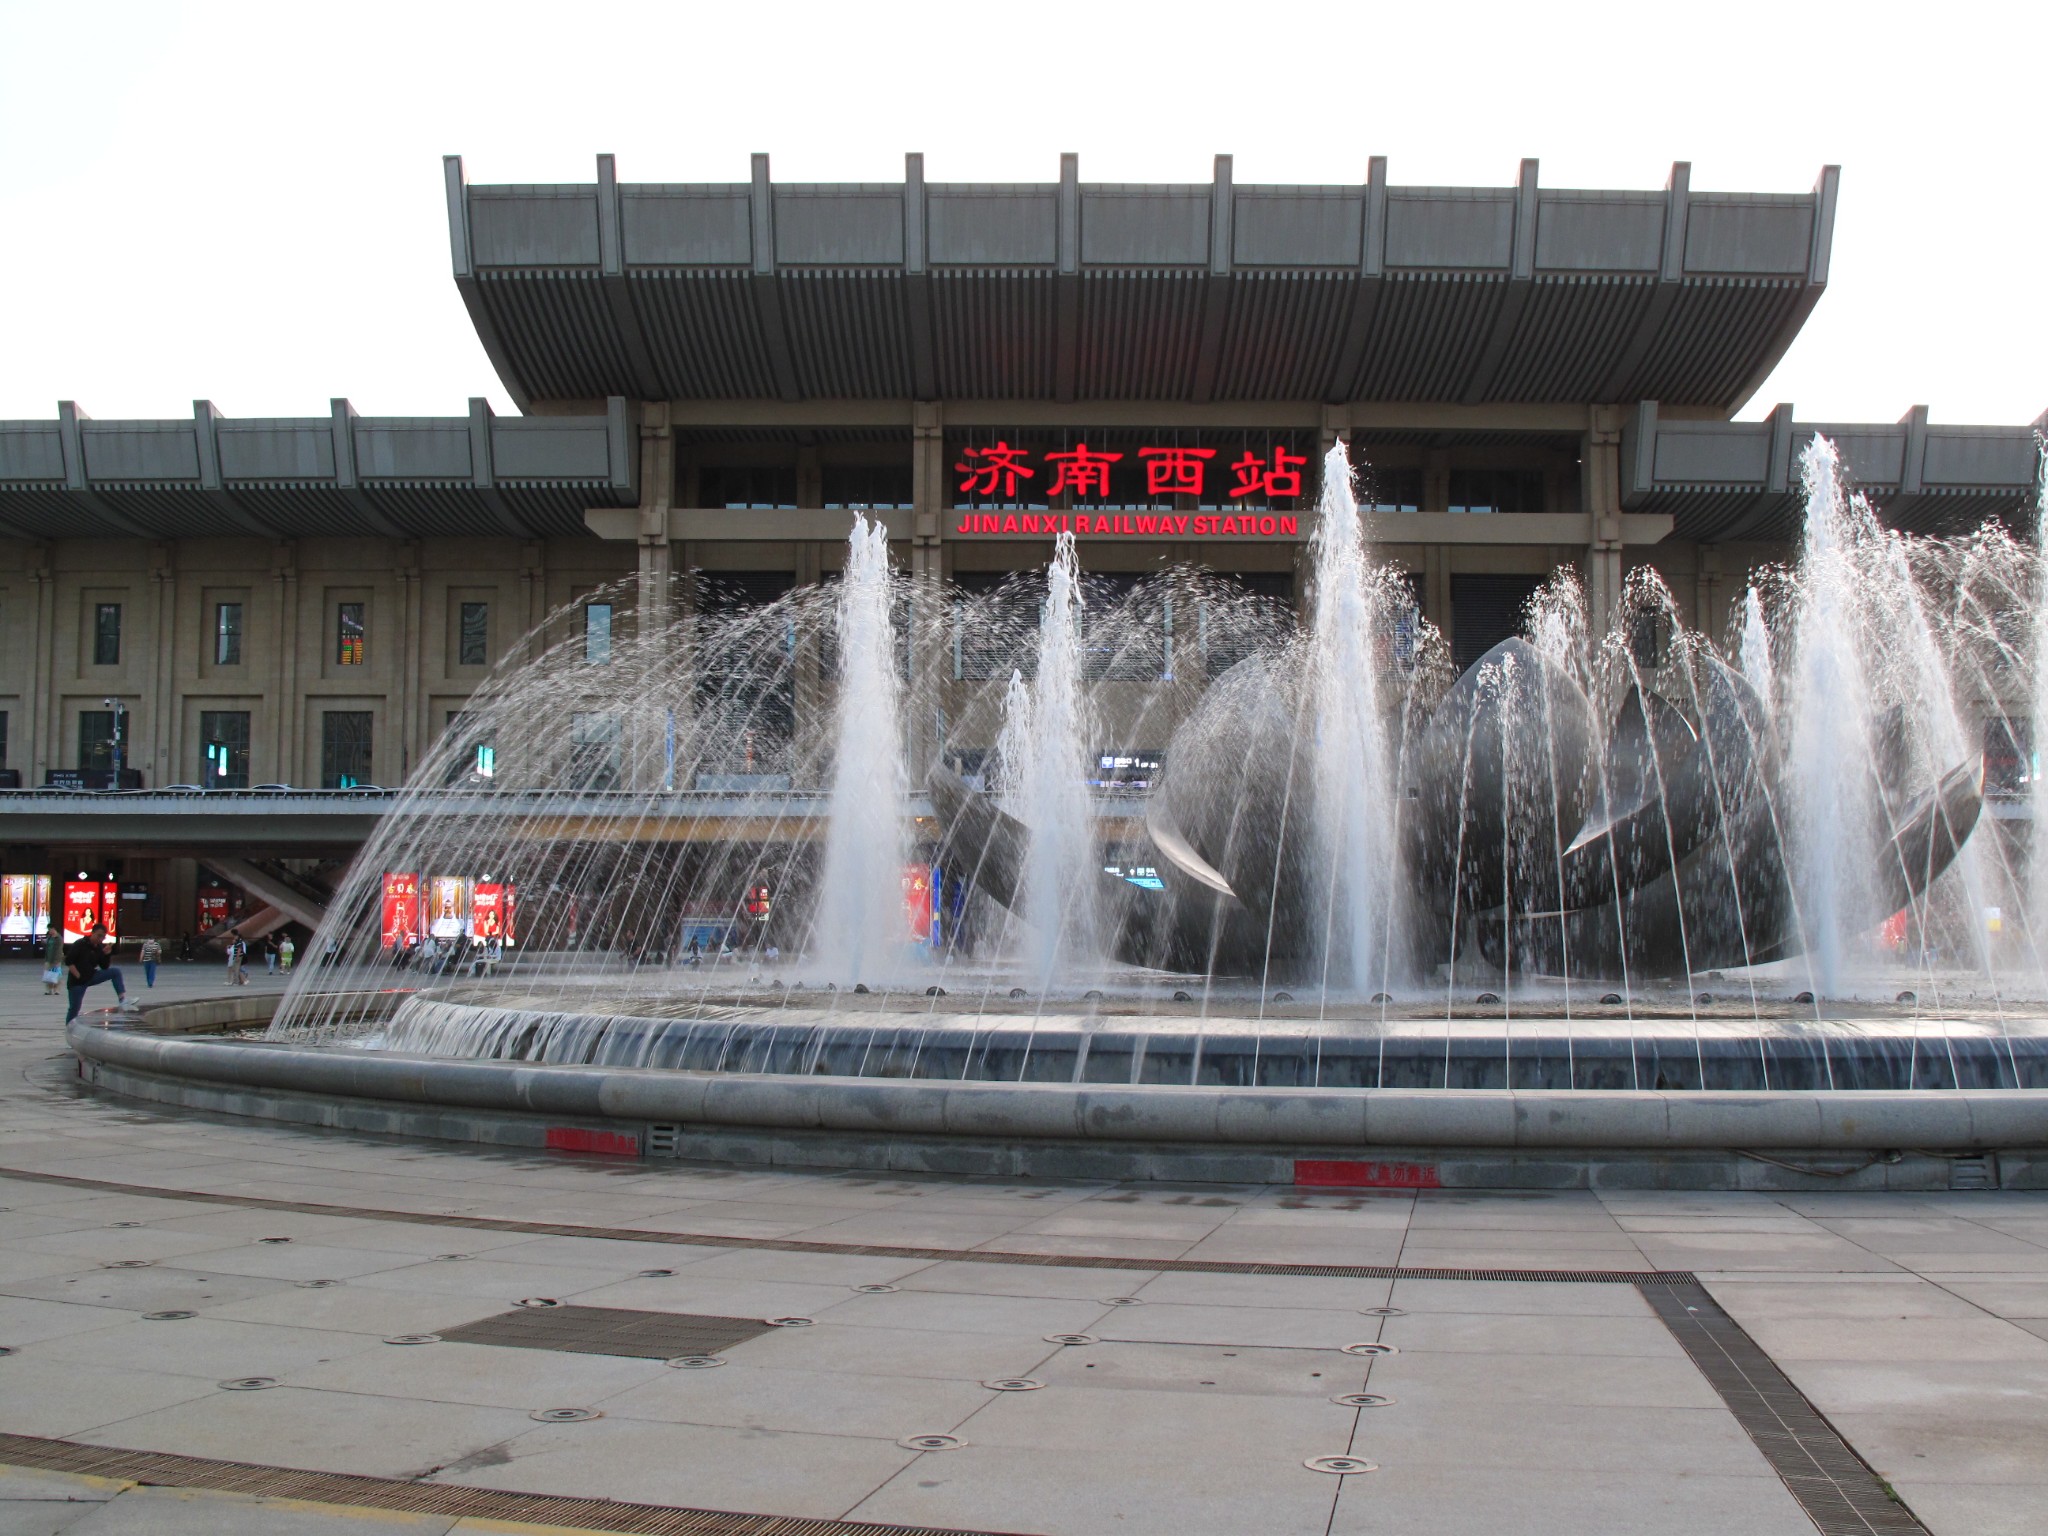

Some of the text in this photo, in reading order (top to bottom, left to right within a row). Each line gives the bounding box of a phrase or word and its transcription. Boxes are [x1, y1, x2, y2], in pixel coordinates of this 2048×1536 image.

[954, 441, 1307, 498] 济南西站
[957, 513, 1297, 536] JINANXI RAILWAY STATION
